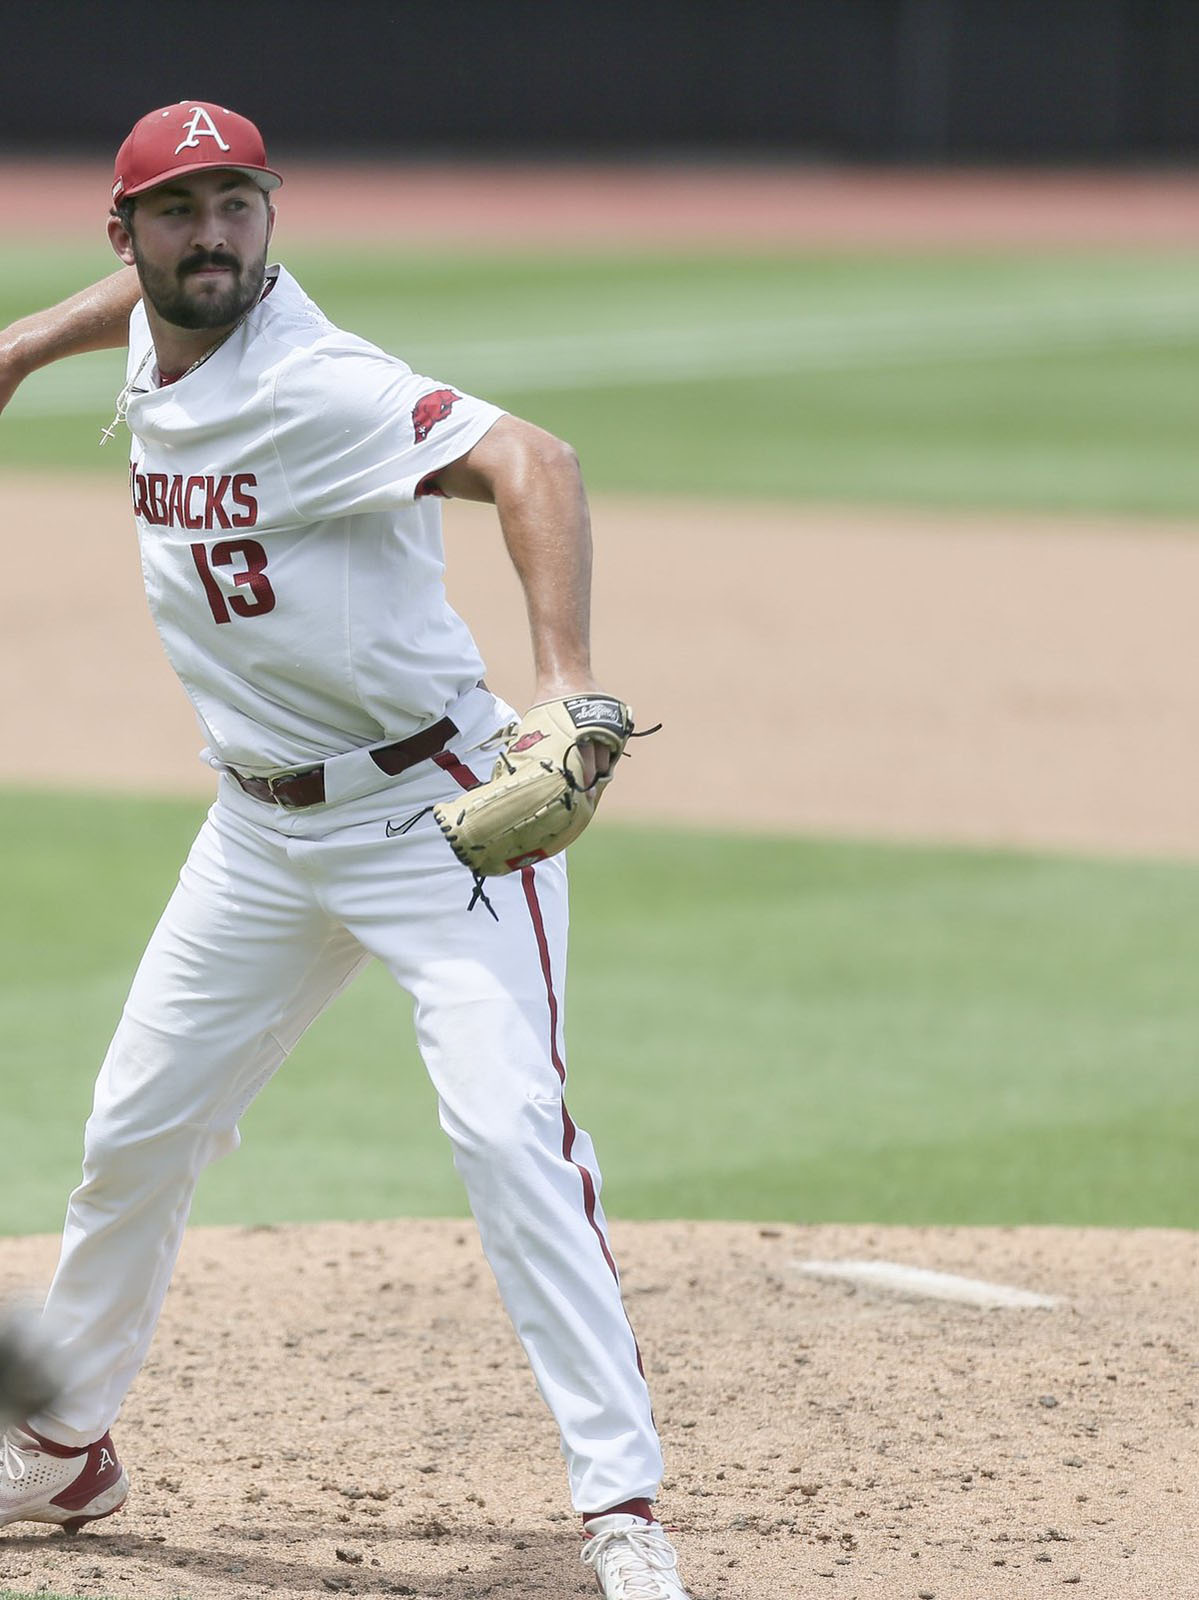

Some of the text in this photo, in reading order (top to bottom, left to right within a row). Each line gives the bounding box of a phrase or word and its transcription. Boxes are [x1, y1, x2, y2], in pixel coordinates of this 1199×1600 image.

[174, 106, 230, 155] A
[132, 463, 258, 530] RBACKS
[190, 539, 276, 625] 13
[97, 1448, 115, 1475] A
